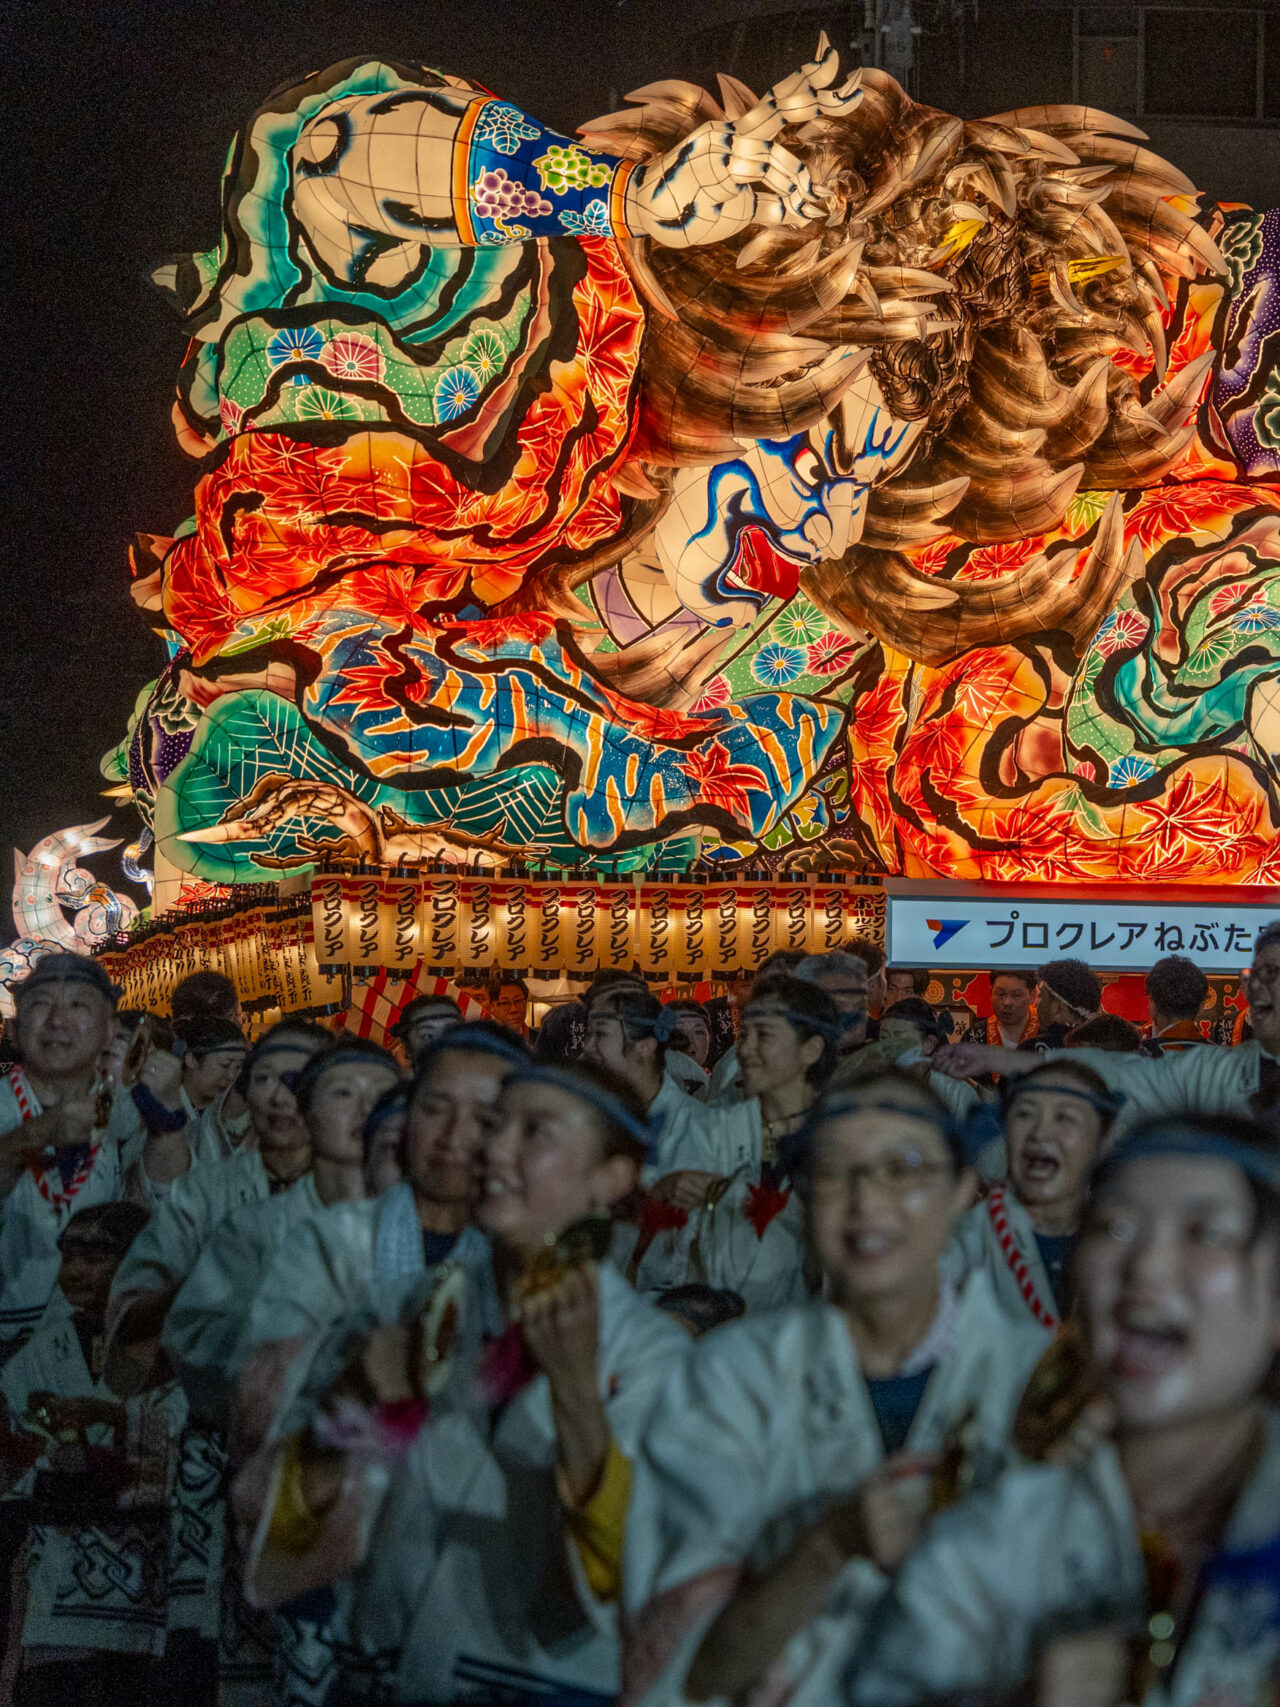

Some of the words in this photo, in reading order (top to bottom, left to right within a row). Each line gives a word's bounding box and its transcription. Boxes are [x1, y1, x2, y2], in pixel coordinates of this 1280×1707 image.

[320, 880, 344, 957] プロクレア
[359, 882, 379, 959] プロクレア
[395, 886, 417, 962] プロクレア
[432, 880, 459, 961] プロクレア
[470, 884, 491, 960] プロクレア
[507, 885, 526, 962] プロクレア
[540, 888, 560, 962] プロクレア
[575, 889, 595, 965] プロクレア
[609, 890, 630, 965] プロクレア
[649, 890, 670, 965] プロクレア
[686, 891, 704, 966] プロクレア
[719, 889, 737, 964] プロクレア
[751, 889, 772, 965] プロクレア
[788, 890, 806, 948] プロクレ
[824, 890, 844, 949] プロクレ
